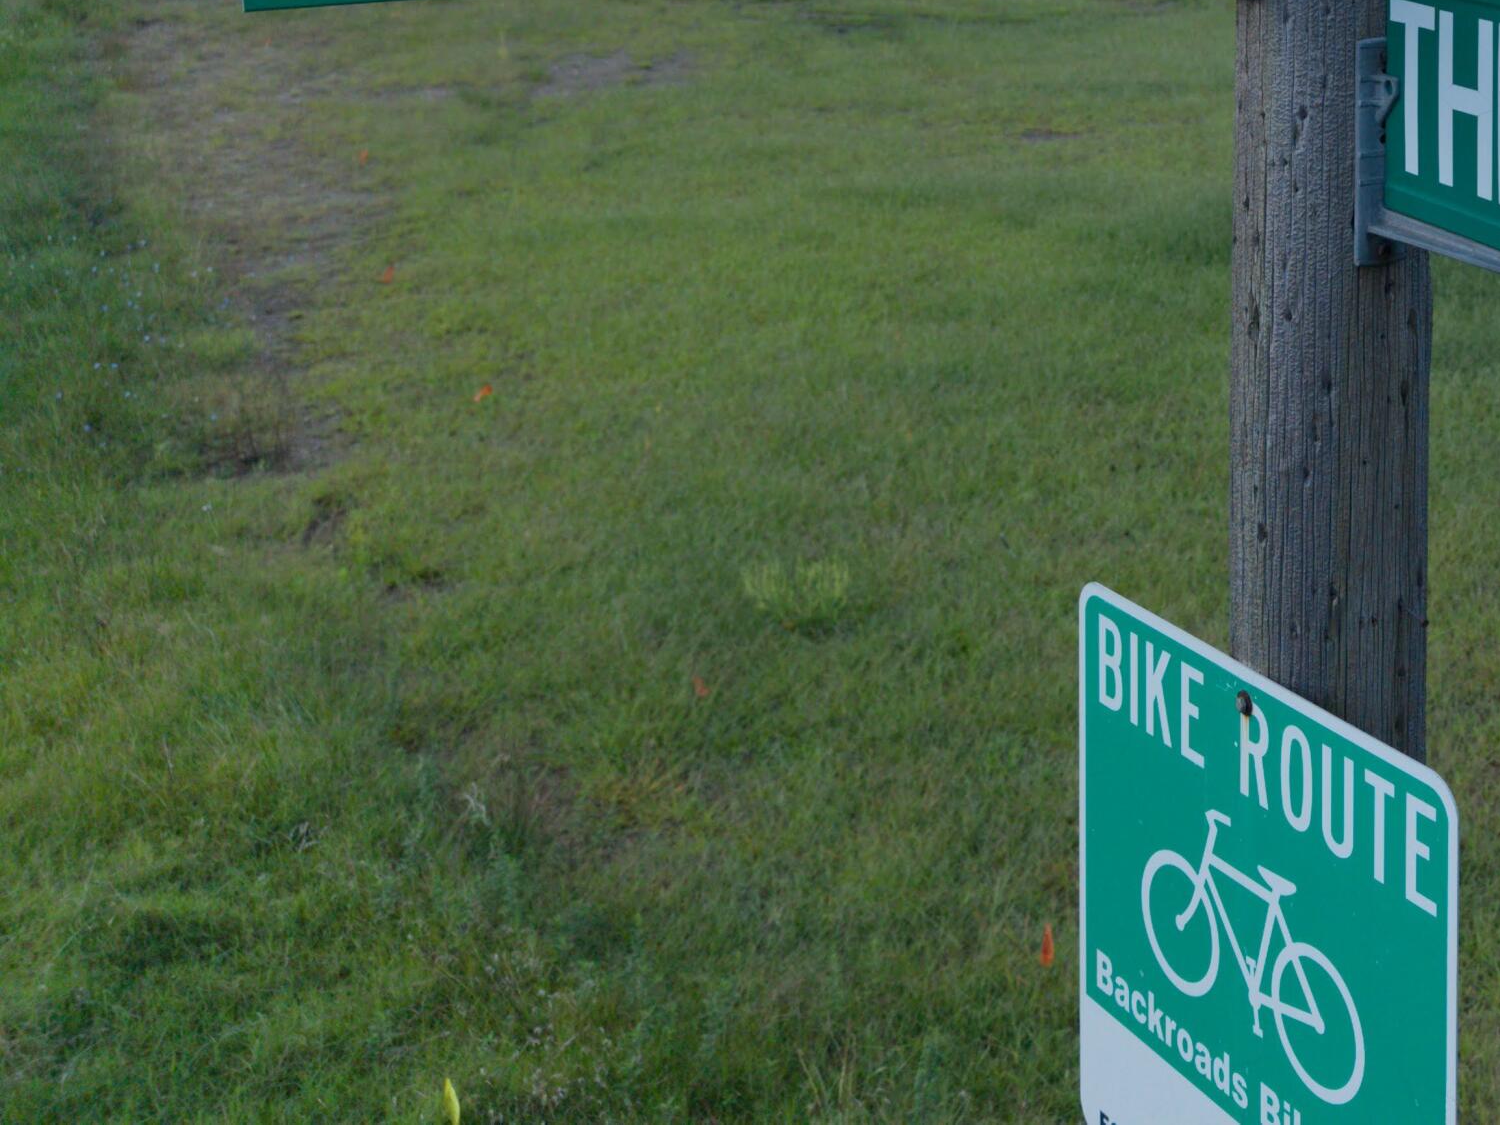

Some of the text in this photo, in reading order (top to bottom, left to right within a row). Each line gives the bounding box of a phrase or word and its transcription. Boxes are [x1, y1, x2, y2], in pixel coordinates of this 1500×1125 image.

[1098, 613, 1437, 917] BIKE ROUTE
[1096, 948, 1248, 1109] Backroads
